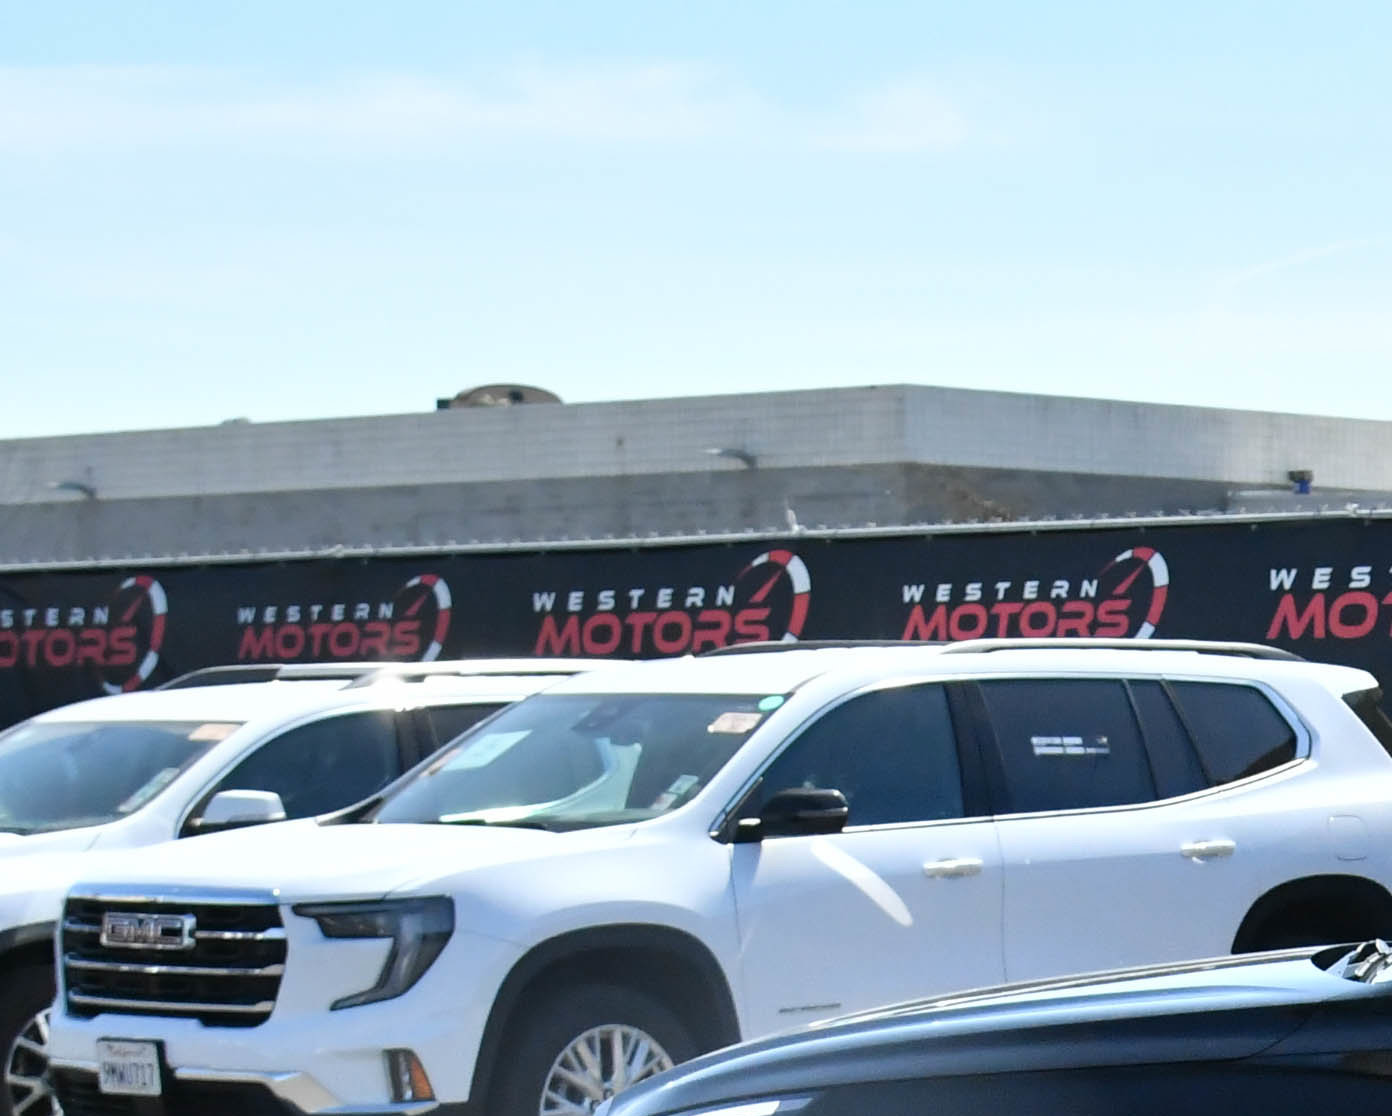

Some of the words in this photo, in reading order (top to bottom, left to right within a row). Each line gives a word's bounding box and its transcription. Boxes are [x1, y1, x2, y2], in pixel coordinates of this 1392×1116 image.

[533, 585, 735, 612] WESTERN
[903, 579, 1099, 603] WESTERN
[238, 602, 394, 624] WESTERN
[903, 599, 1132, 641] MOTORS
[239, 620, 422, 660] MOTORS
[534, 607, 771, 656] MOTORS
